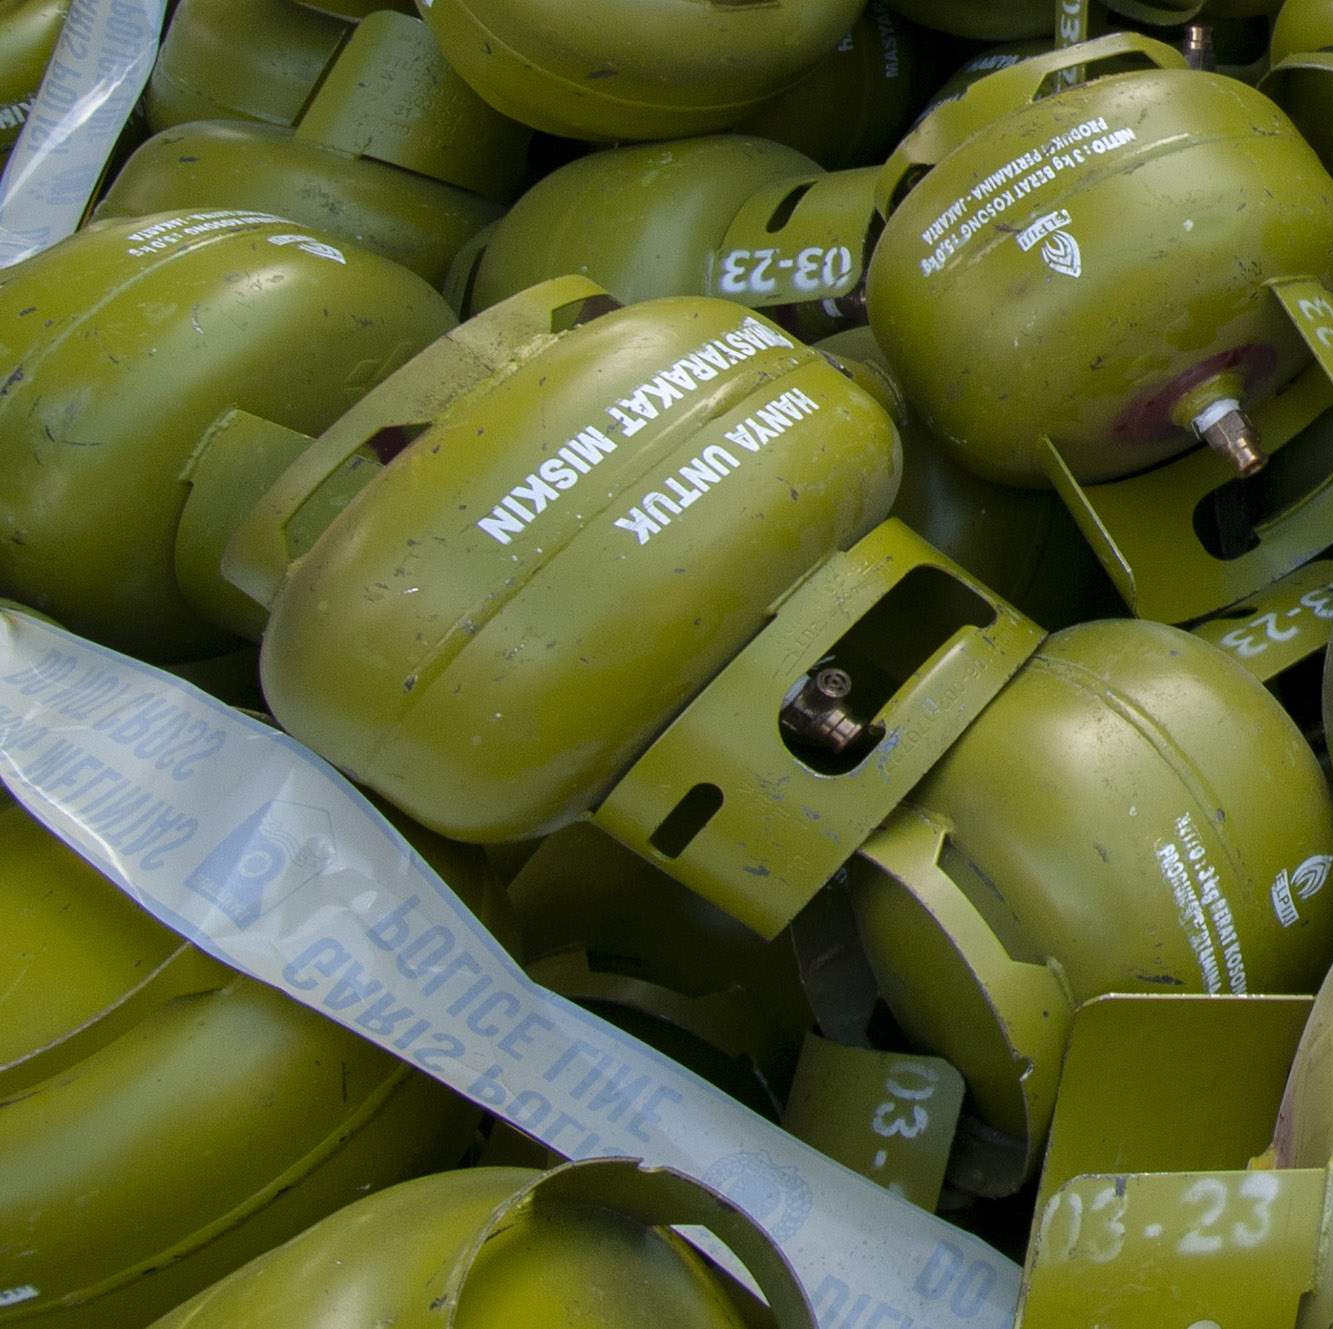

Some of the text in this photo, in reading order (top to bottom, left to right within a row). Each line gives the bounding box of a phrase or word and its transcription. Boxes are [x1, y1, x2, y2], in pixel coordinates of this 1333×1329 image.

[1090, 127, 1137, 154] NETTO
[976, 147, 1043, 200] PERTAMINA
[1012, 164, 1056, 199] BERAT
[921, 199, 968, 246] JAKARTA
[960, 189, 1016, 239] KOSONG
[718, 245, 853, 295] 03-23
[476, 315, 795, 546] MASYARAKAT MISKIN
[613, 386, 821, 546] HANYA UNTUK
[1224, 941, 1248, 996] KOSON
[1040, 1171, 1279, 1265] 03-23
